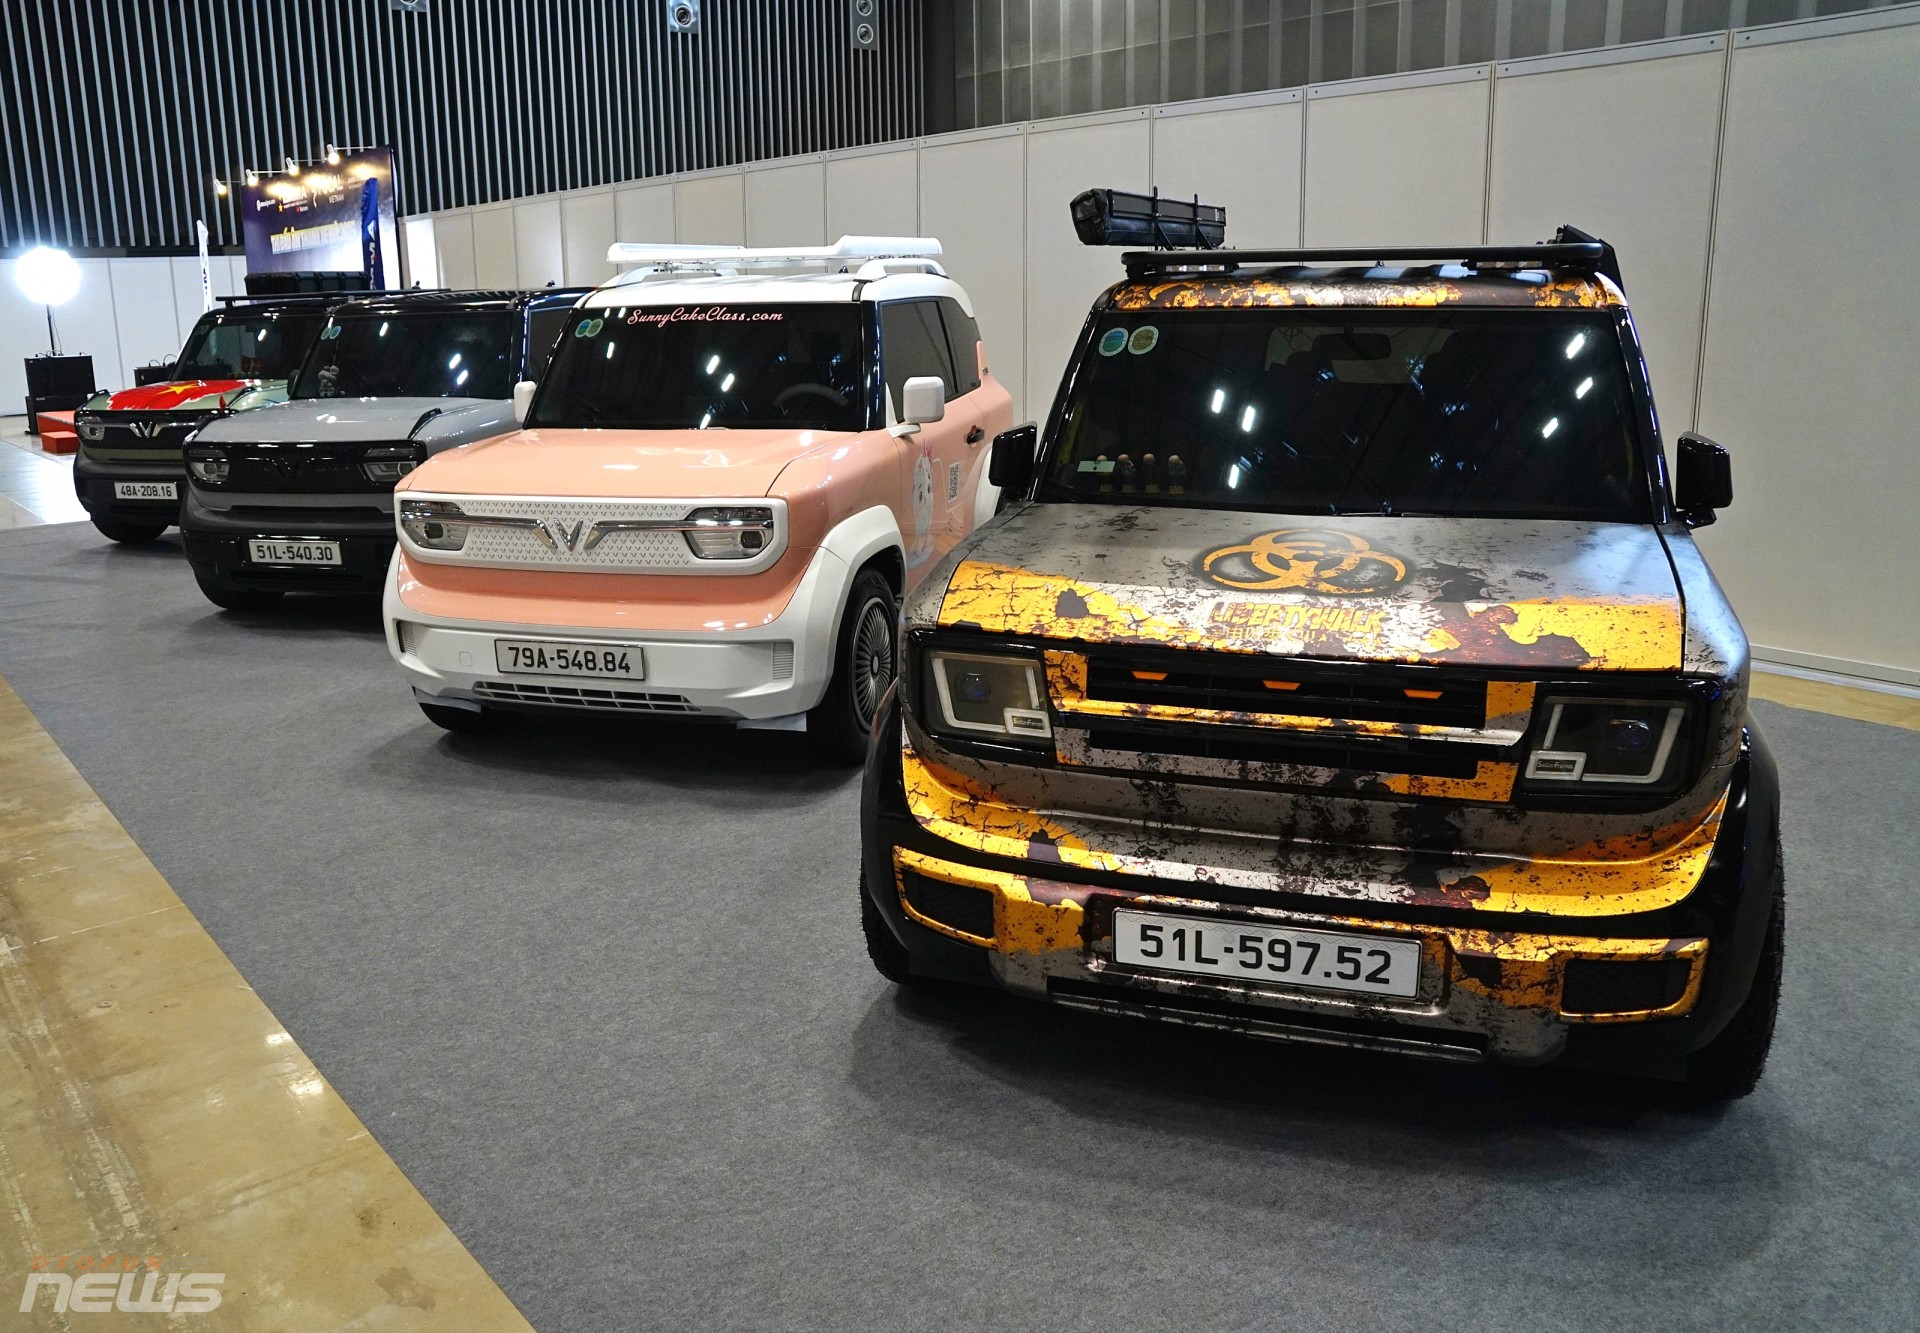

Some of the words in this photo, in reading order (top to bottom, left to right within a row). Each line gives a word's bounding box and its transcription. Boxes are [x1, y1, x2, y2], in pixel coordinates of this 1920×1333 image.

[627, 306, 784, 328] SunnyCakeClass.com
[120, 485, 173, 497] 48A-208.16
[256, 544, 333, 561] 51L-540.30
[507, 646, 631, 673] 79A-548.84
[1140, 923, 1391, 985] 51L-597.52
